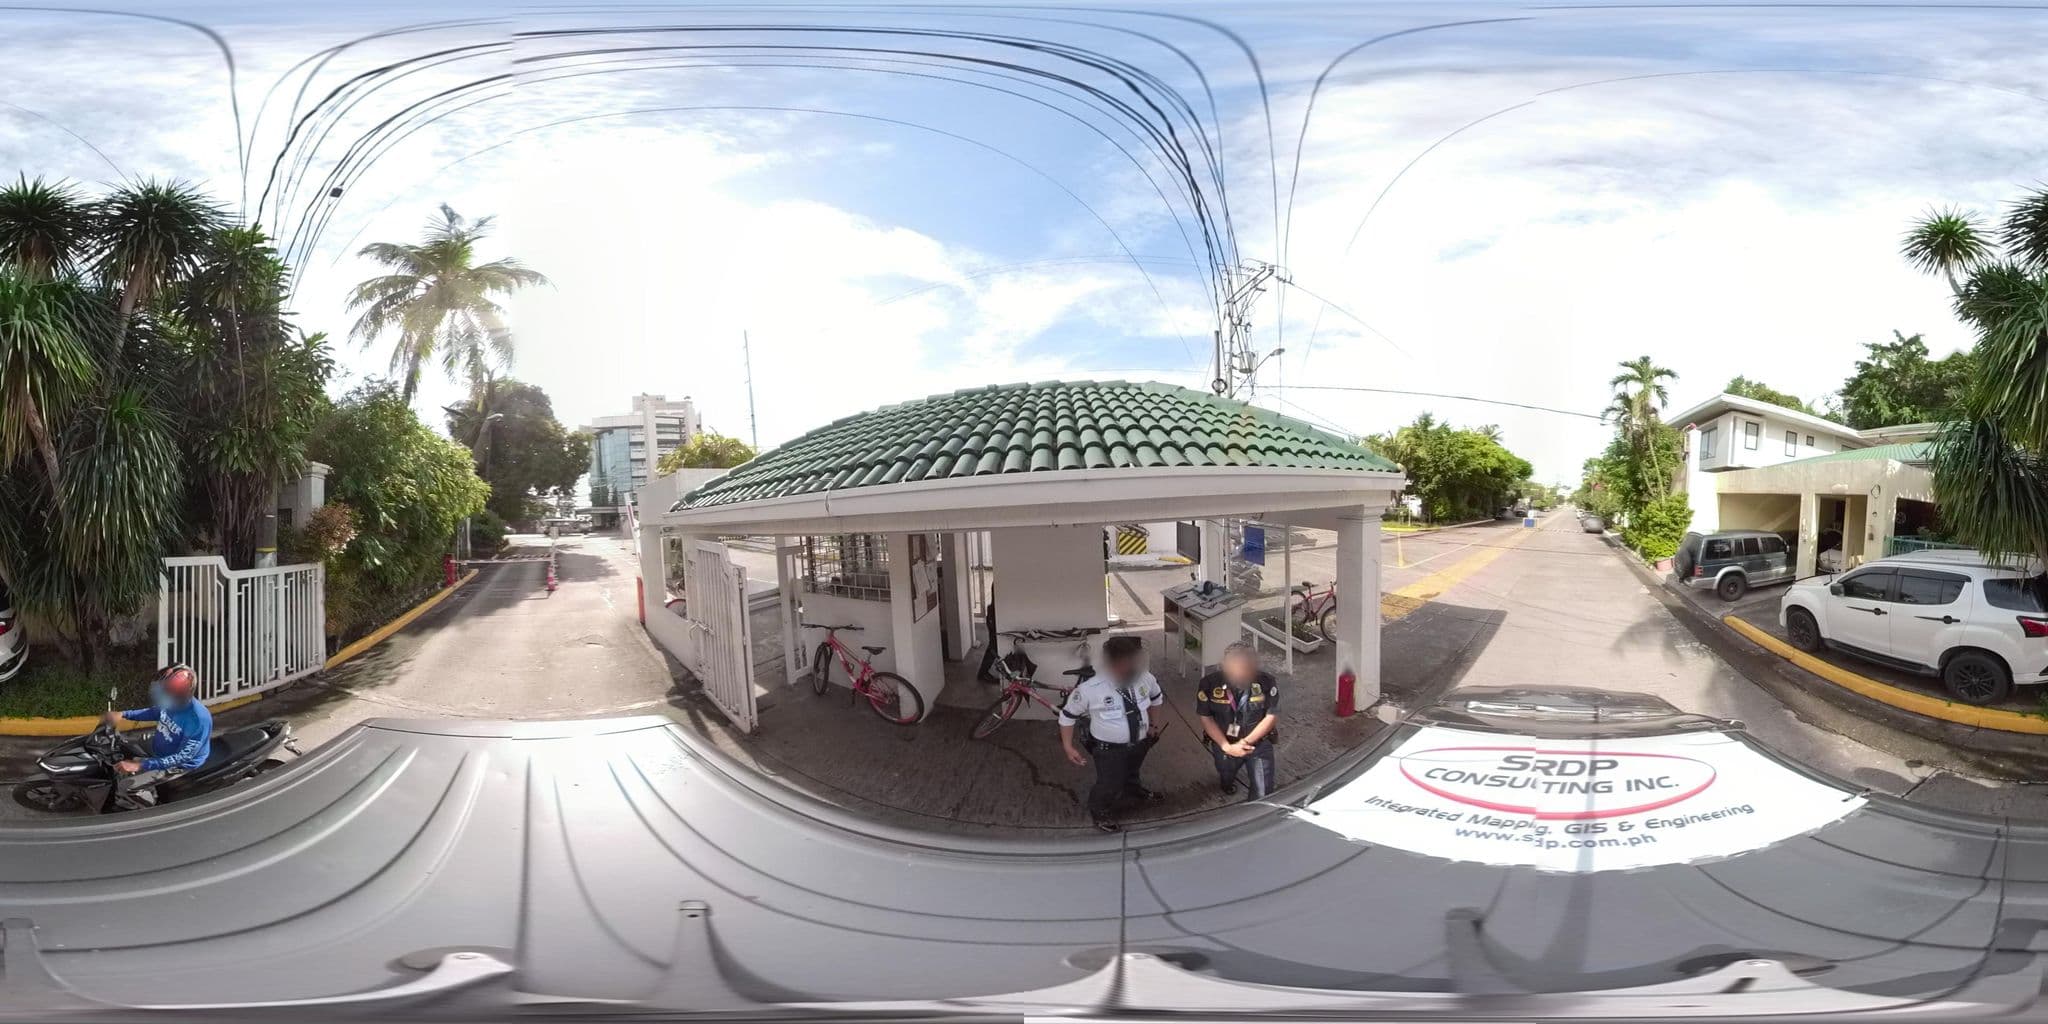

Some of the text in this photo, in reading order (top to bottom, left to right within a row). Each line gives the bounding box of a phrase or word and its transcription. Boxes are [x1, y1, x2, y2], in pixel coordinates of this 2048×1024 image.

[1497, 755, 1619, 776] SRDP
[1626, 776, 1679, 792] INC.
[1364, 795, 1464, 822] Integrated
[1564, 822, 1608, 835] GIS
[1618, 821, 1635, 832] &
[1645, 803, 1755, 830] Engineering
[1455, 828, 1657, 849] www.sdp.com.ph
